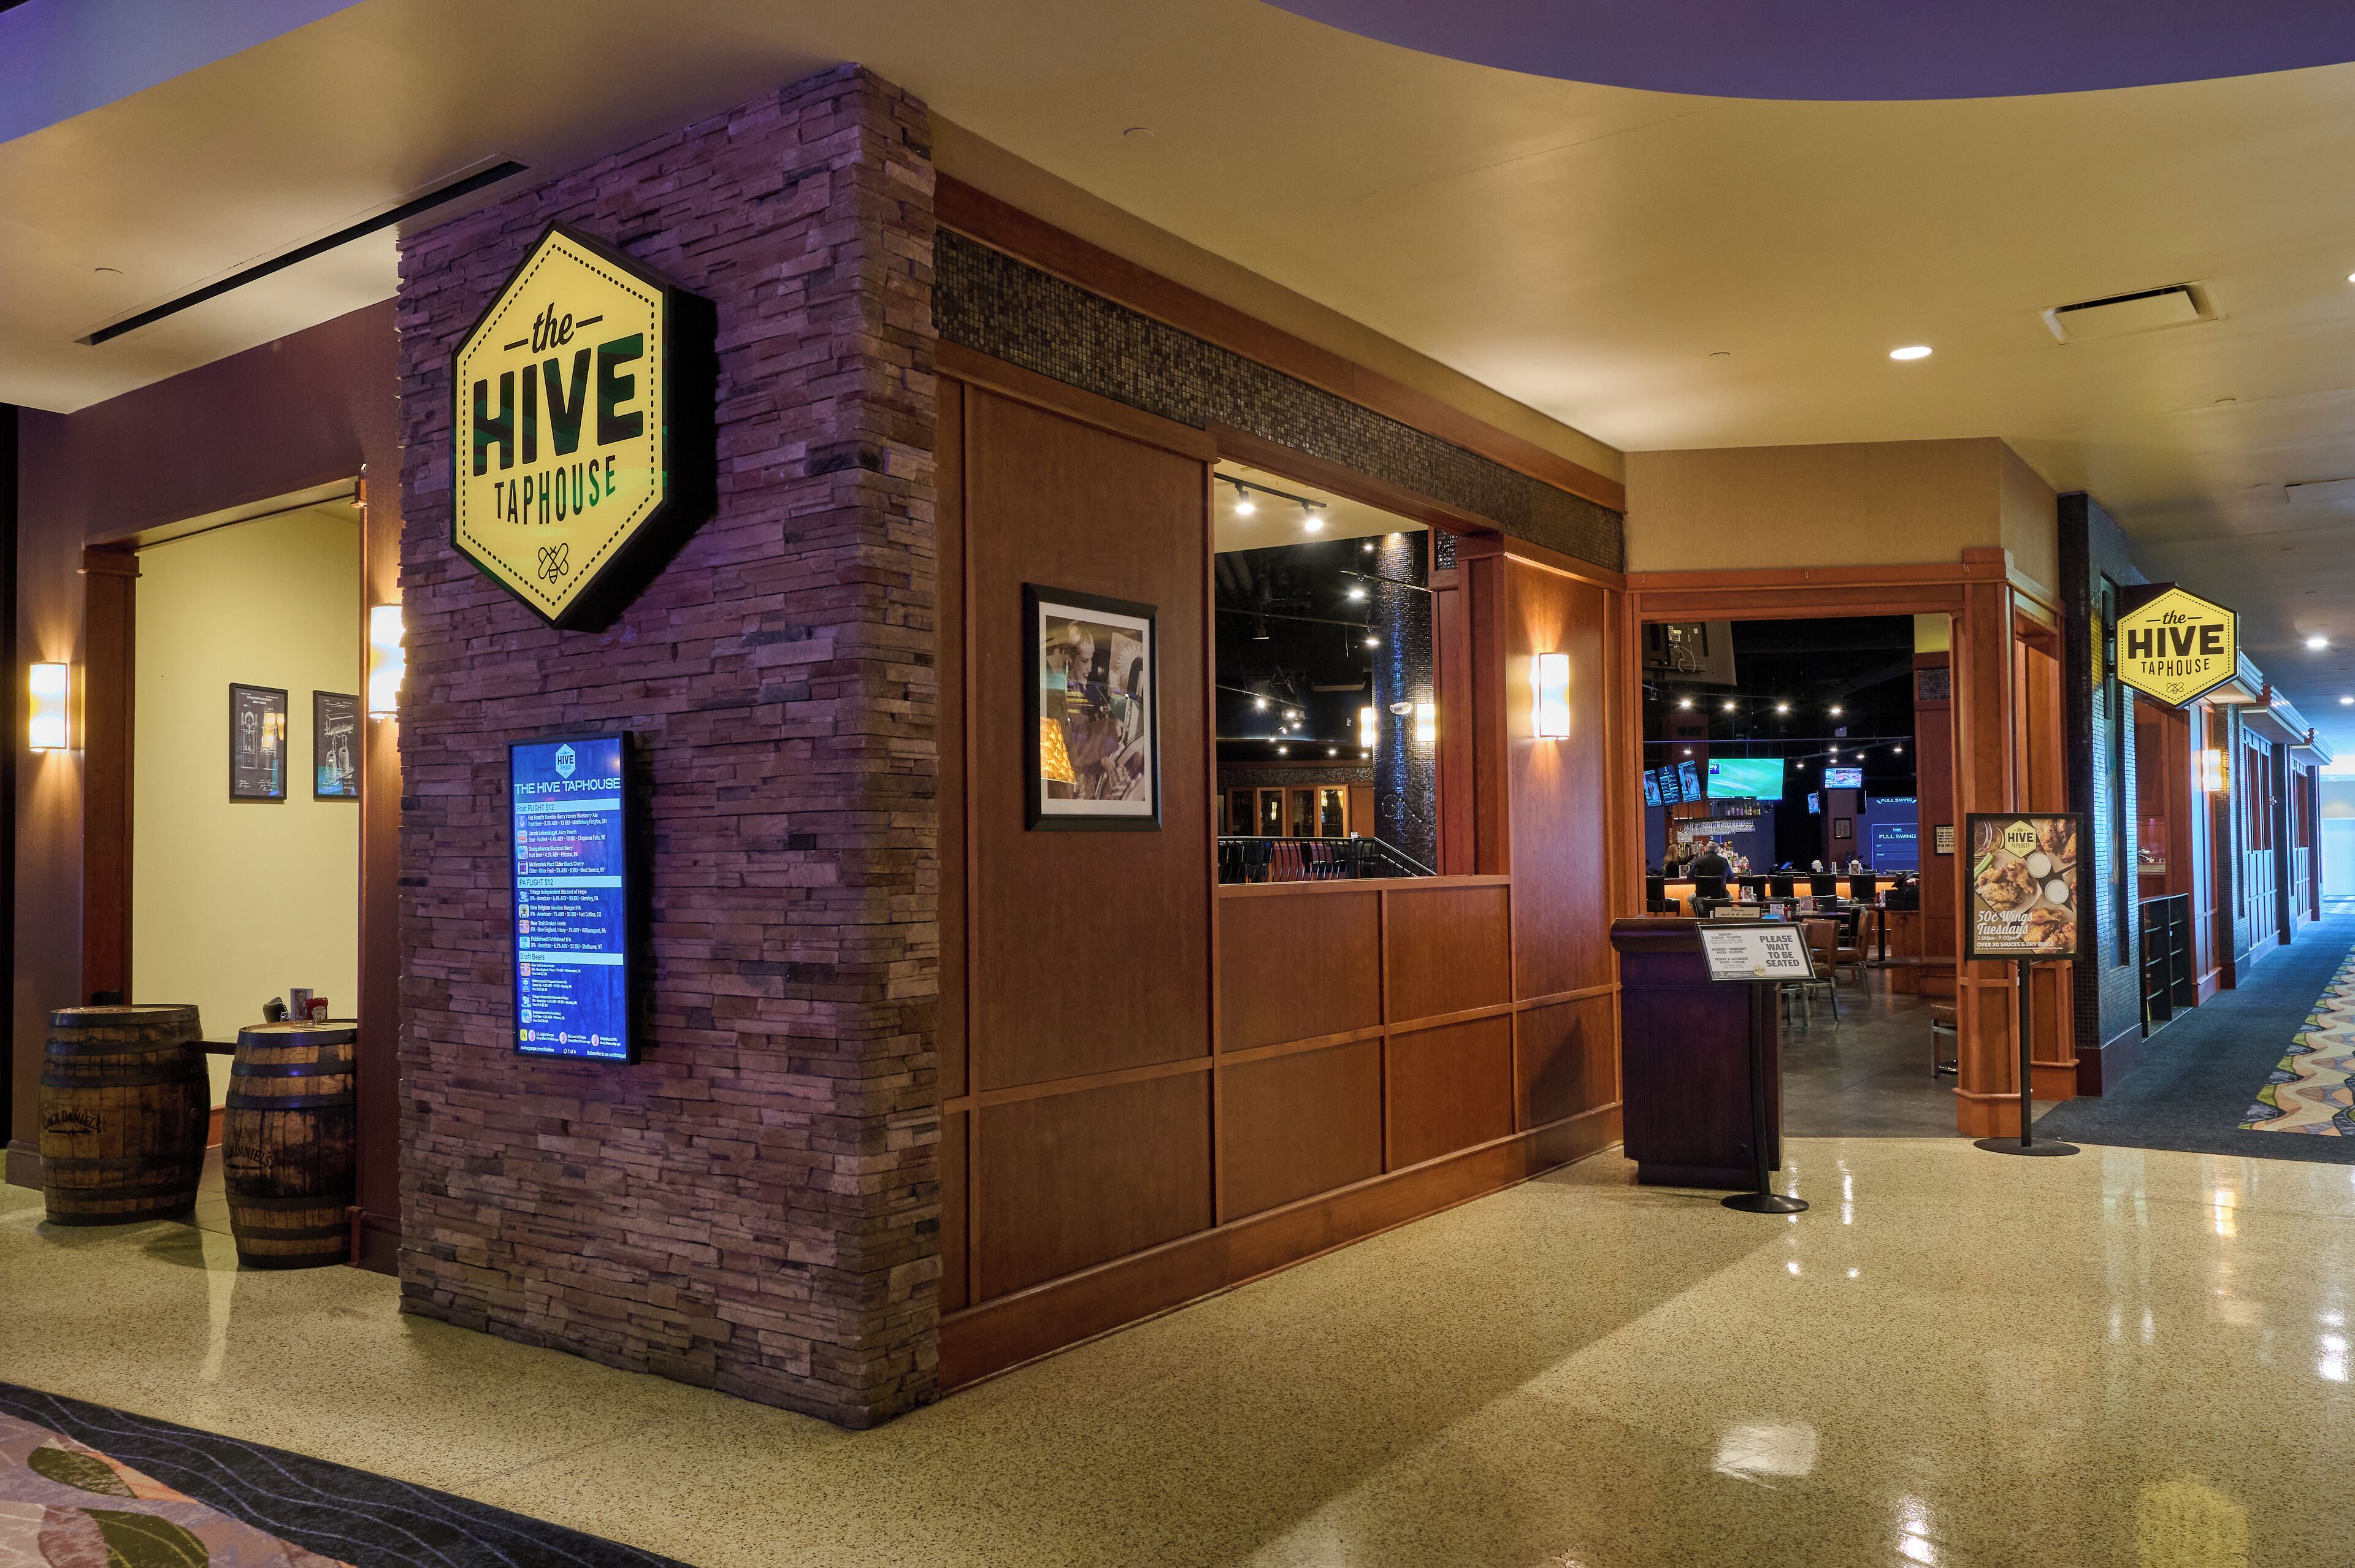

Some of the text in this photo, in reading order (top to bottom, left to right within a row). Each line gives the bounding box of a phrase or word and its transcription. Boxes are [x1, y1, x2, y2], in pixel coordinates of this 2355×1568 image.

[532, 303, 575, 353] the
[473, 332, 643, 476] HIVE
[494, 454, 616, 525] TAPHOUSE
[2163, 610, 2187, 624] the
[2128, 624, 2224, 659] HIVE
[2142, 659, 2210, 676] TAPHOUSE
[557, 755, 573, 765] HIVE
[515, 778, 620, 794] THE HIVE TAPHOUSE
[2008, 832, 2034, 842] HIVE
[1977, 911, 2033, 924] 50¢ Wings
[1977, 922, 2028, 939] Tuesdays
